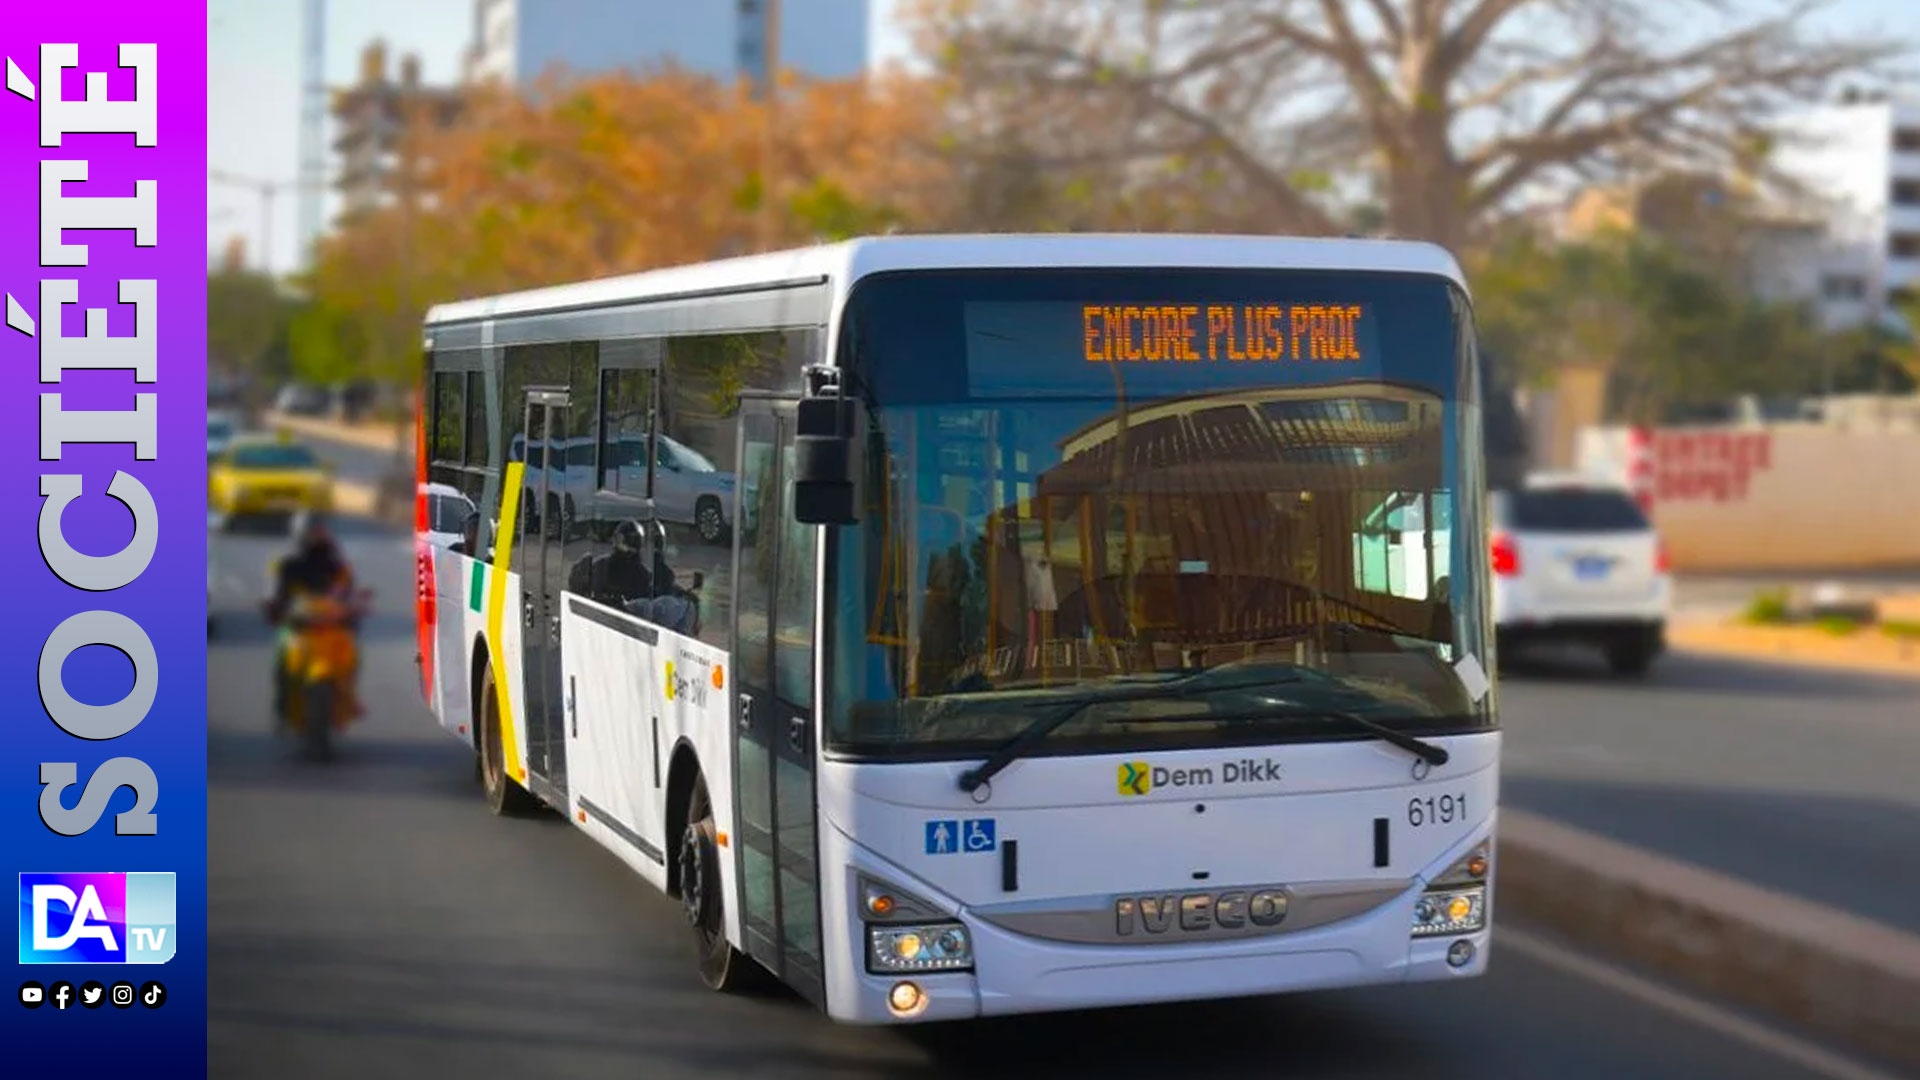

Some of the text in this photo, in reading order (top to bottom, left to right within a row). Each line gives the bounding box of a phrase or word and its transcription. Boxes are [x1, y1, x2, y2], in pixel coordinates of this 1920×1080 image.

[1083, 305, 1362, 361] ENCORE PLUS PROC
[1153, 758, 1281, 787] Dem Dikk
[1408, 793, 1467, 828] 6191
[1114, 888, 1289, 936] IVECO
